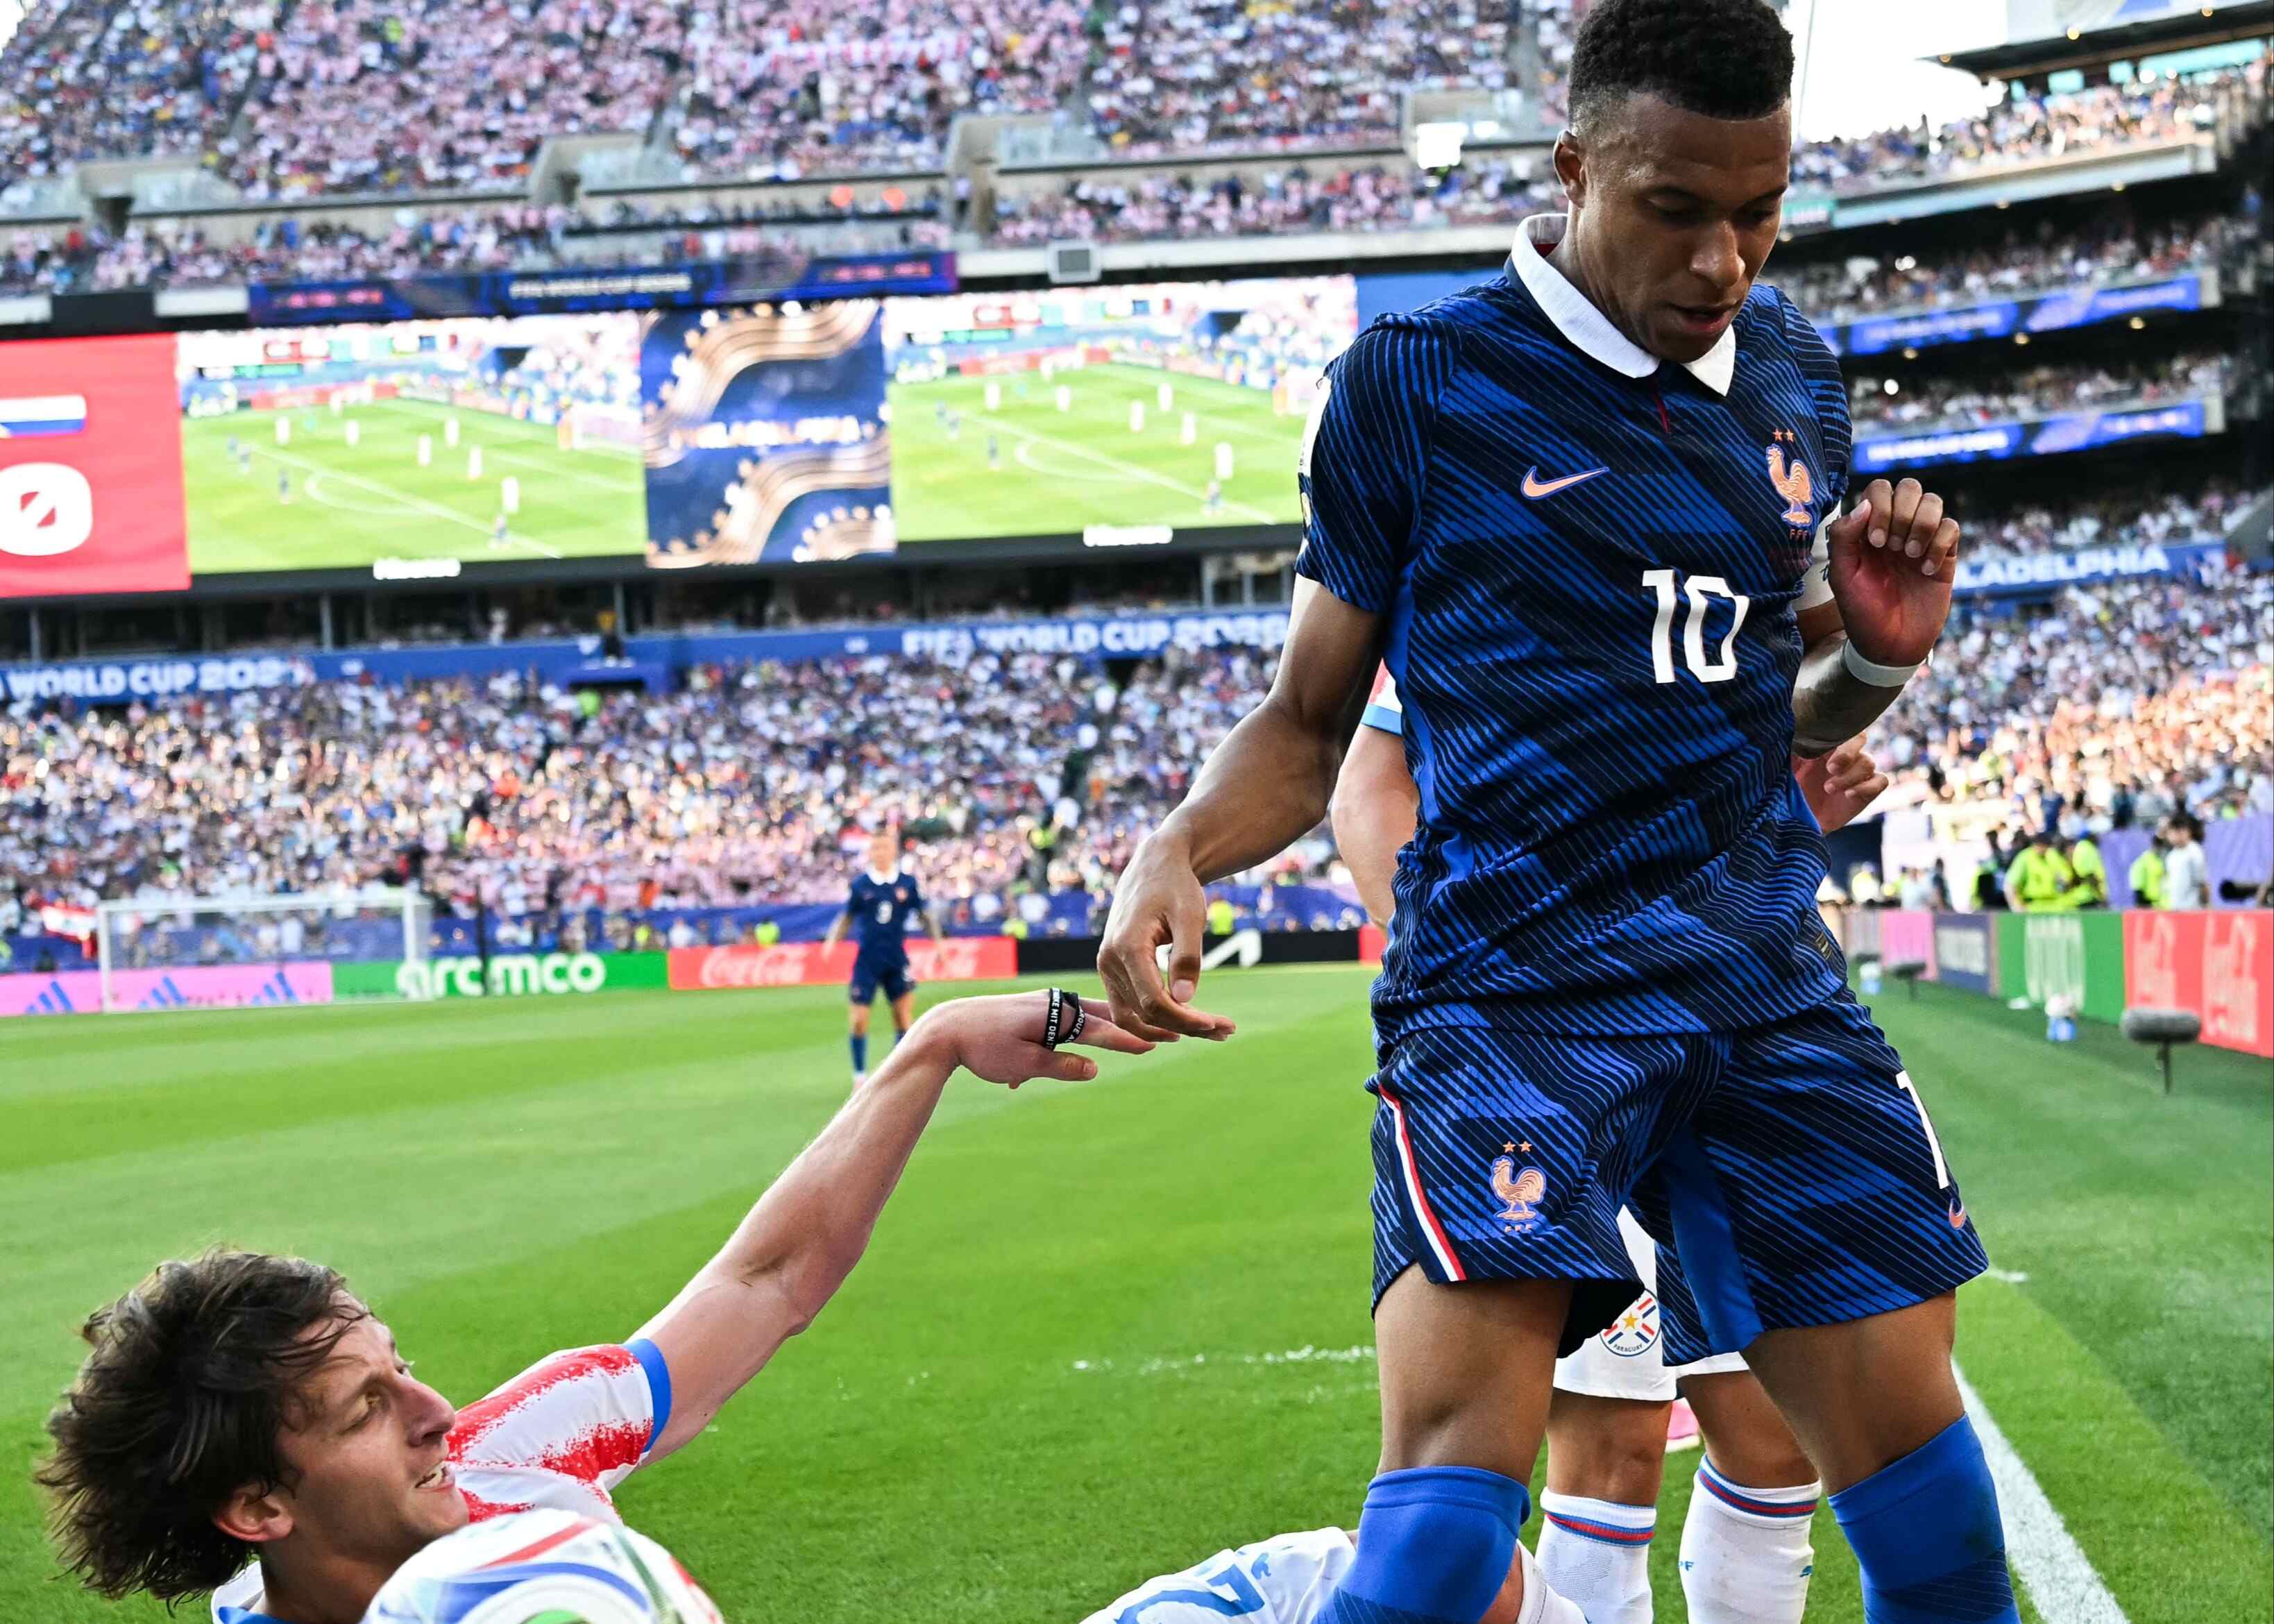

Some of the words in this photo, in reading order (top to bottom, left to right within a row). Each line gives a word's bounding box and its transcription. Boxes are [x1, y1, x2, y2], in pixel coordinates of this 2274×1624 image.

[0, 462, 93, 557] 0
[1102, 617, 1171, 652] CUP
[1642, 568, 1750, 684] 10
[6, 666, 127, 697] WORLD
[128, 661, 196, 695] CUP
[1050, 1008, 1059, 1024] MIT
[1046, 1026, 1057, 1042] DEN
[1613, 1343, 1643, 1353] PARAGUAY
